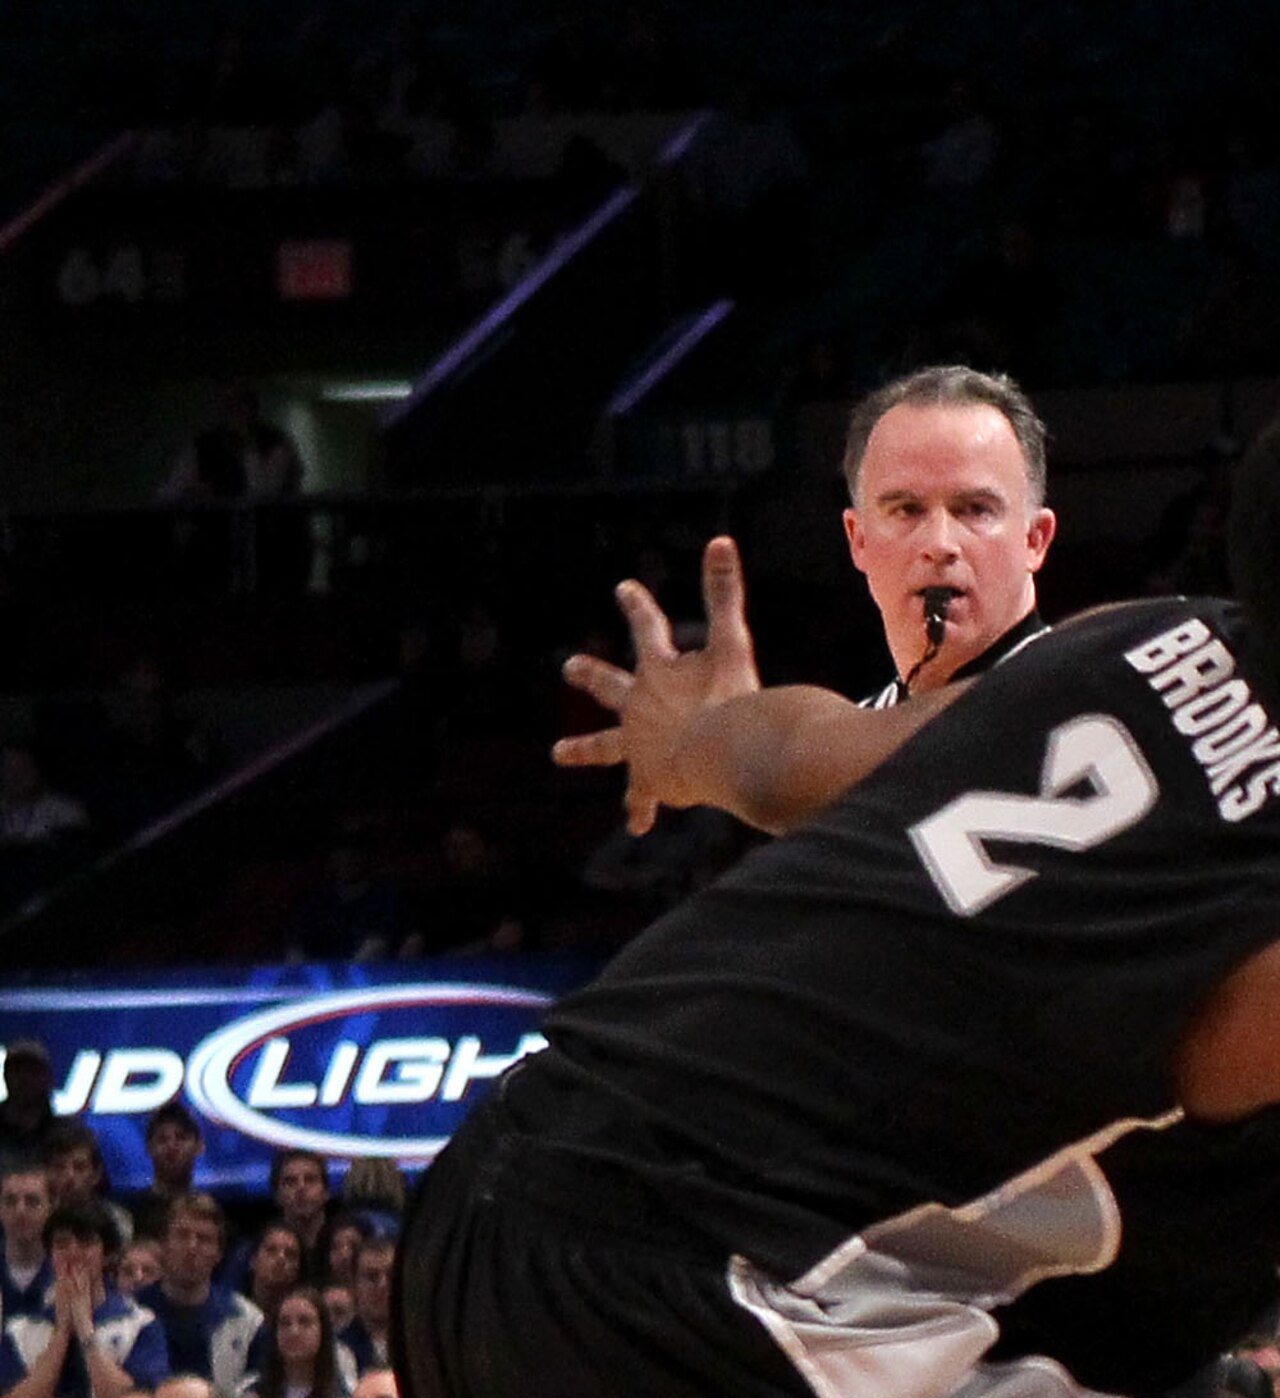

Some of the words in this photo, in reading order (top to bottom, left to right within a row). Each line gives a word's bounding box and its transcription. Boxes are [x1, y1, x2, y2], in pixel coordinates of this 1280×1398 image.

[906, 712, 1160, 918] 2
[0, 1046, 184, 1115] UD
[246, 1036, 550, 1107] LIGH
